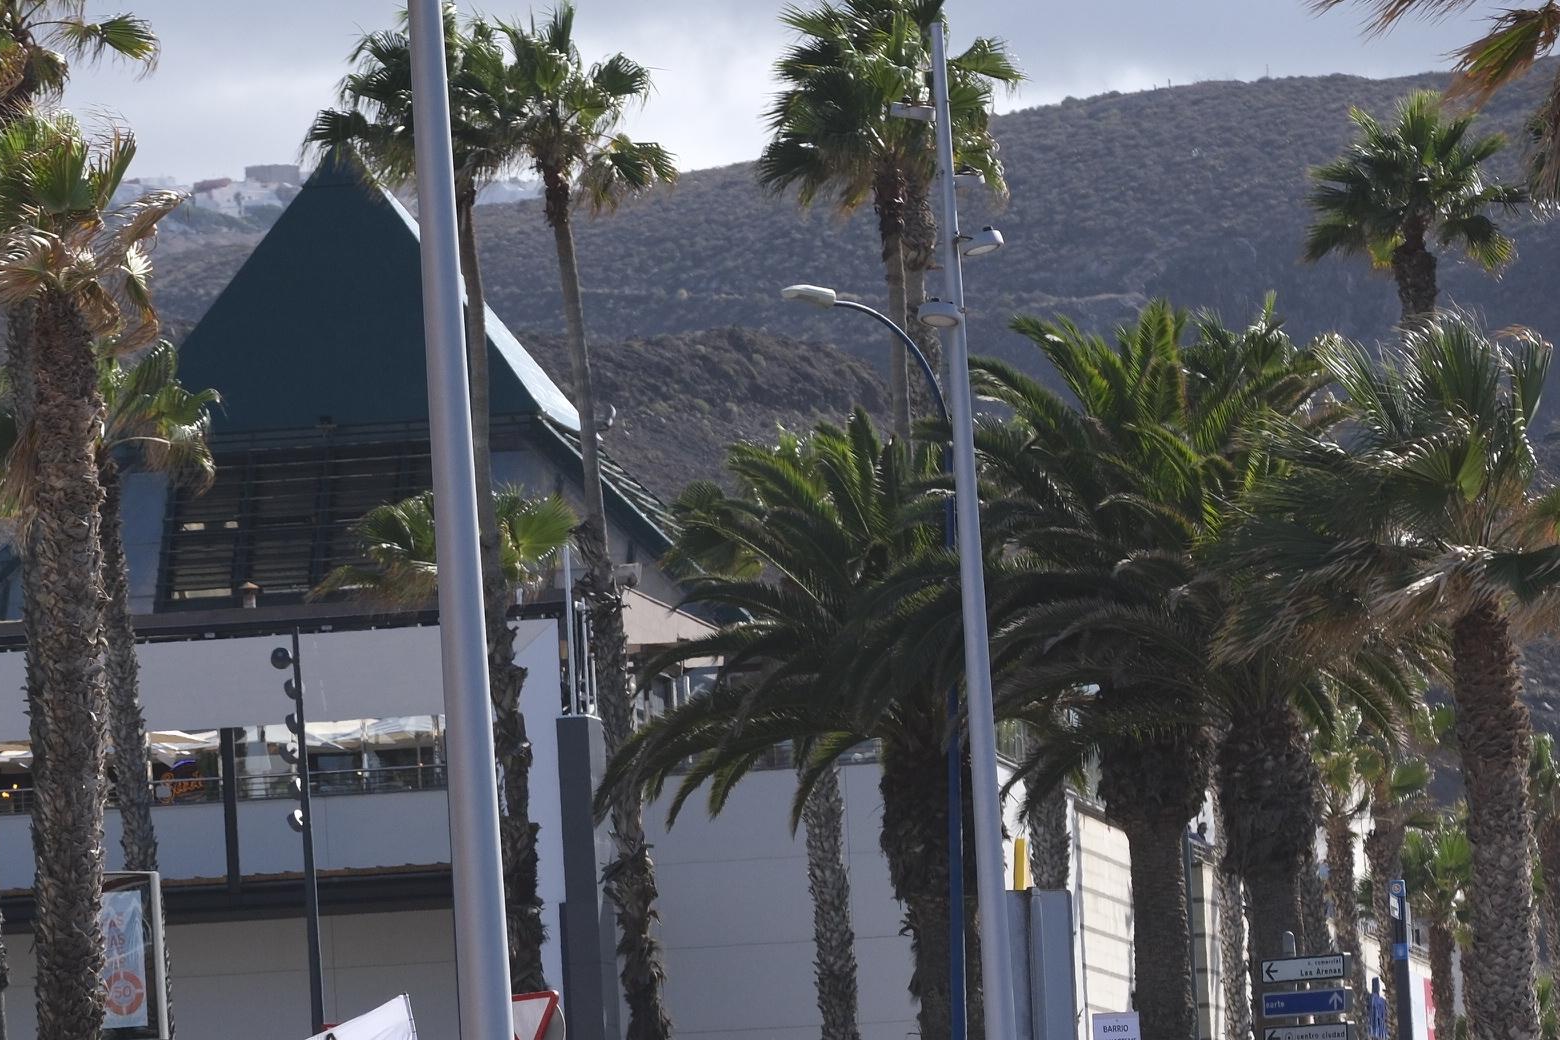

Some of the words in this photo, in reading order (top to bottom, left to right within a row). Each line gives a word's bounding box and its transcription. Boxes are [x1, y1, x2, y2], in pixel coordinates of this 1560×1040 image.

[1300, 968, 1313, 977] Las
[1316, 967, 1342, 975] Arenas
[1103, 1025, 1129, 1033] BARRIO
[1296, 1031, 1319, 1040] centro
[1322, 1030, 1345, 1039] ciudad
